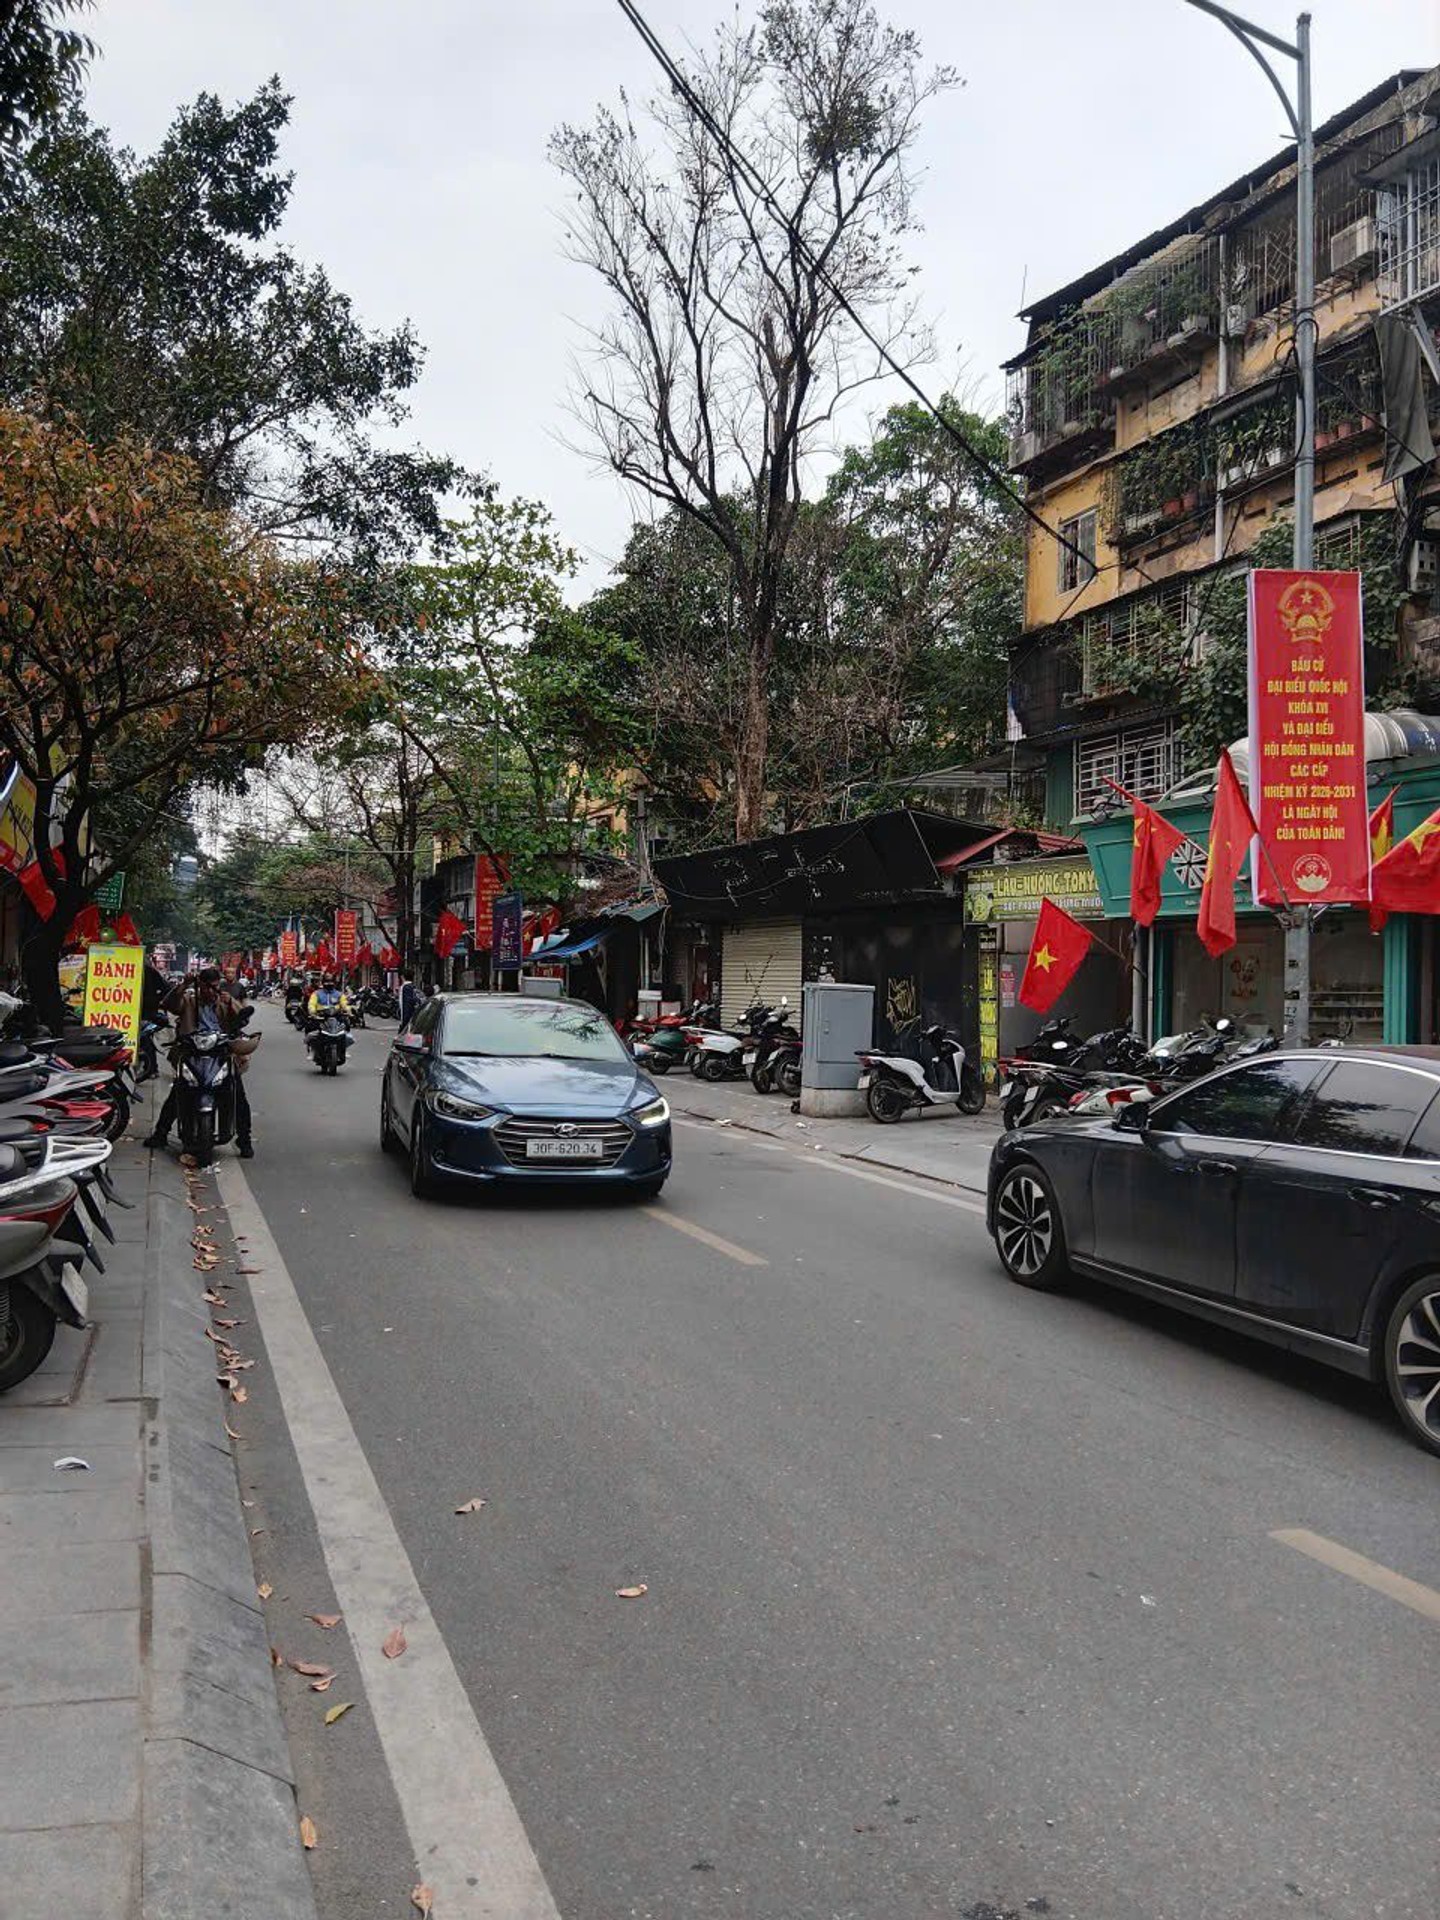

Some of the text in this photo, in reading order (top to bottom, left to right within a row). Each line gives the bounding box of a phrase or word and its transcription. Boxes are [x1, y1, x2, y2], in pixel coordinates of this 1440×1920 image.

[1288, 699, 1314, 714] KHÓA
[1282, 720, 1295, 735] VÀ
[1290, 762, 1309, 777] CÁC
[1282, 804, 1294, 819] LÀ
[1276, 824, 1295, 840] CỦA
[93, 958, 136, 979] BÁNH
[91, 982, 133, 1004] CUỐN
[89, 1010, 132, 1030] NÓNG
